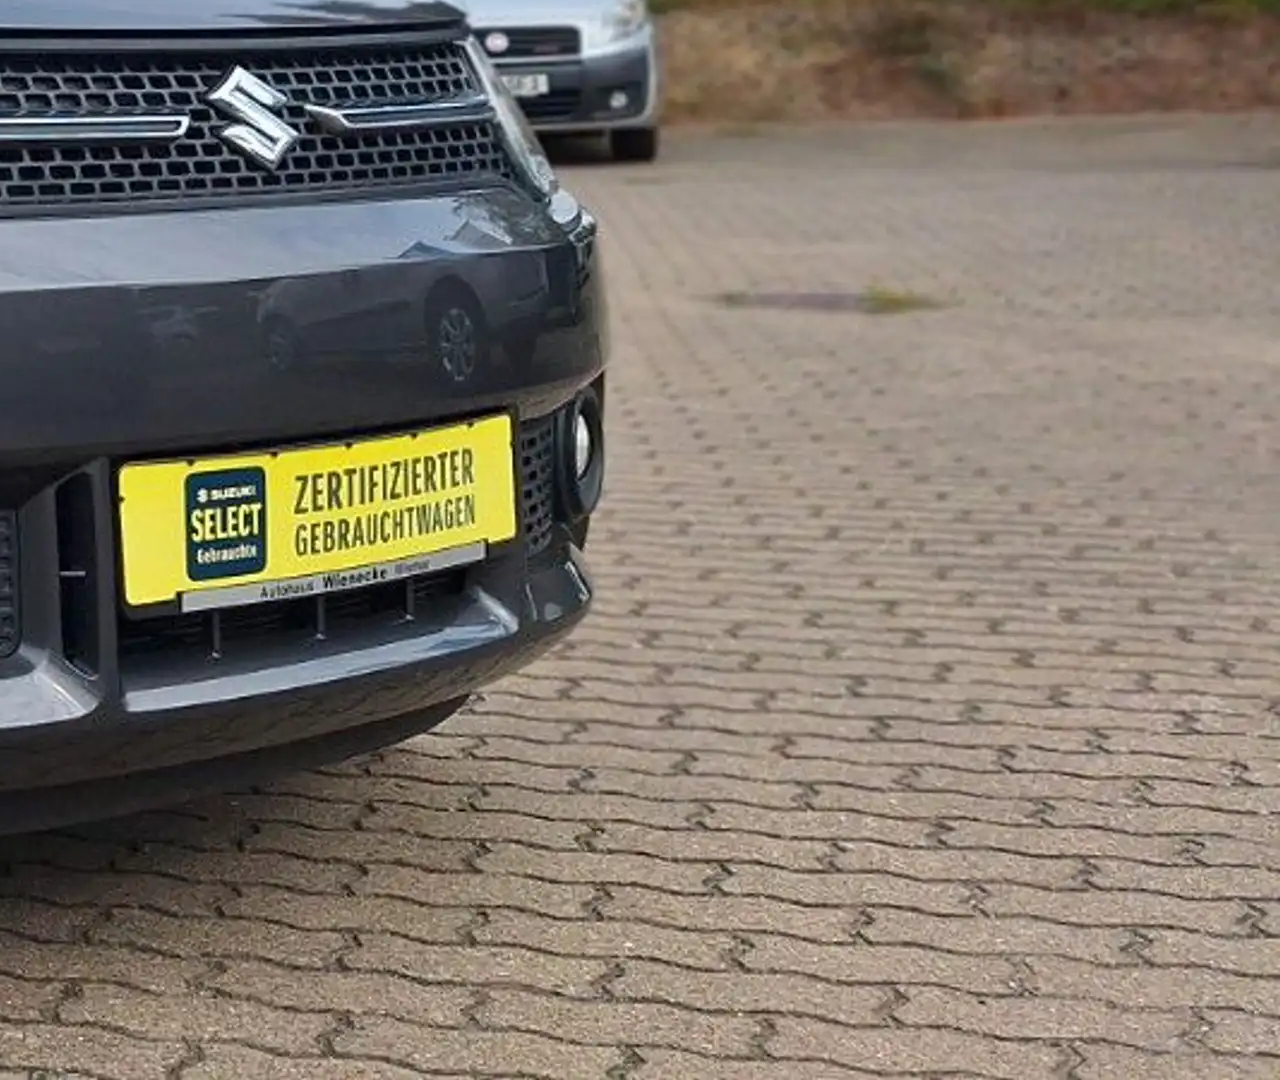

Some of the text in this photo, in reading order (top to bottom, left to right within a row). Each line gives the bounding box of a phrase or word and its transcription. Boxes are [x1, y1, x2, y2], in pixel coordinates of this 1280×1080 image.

[210, 485, 257, 500] SUZUKI
[294, 448, 474, 515] ZERTIFIZIERTER
[191, 503, 262, 543] SELECT
[295, 494, 475, 557] GEBRAUCHTWAGEN
[260, 567, 387, 599] Autohaus Wienecke
